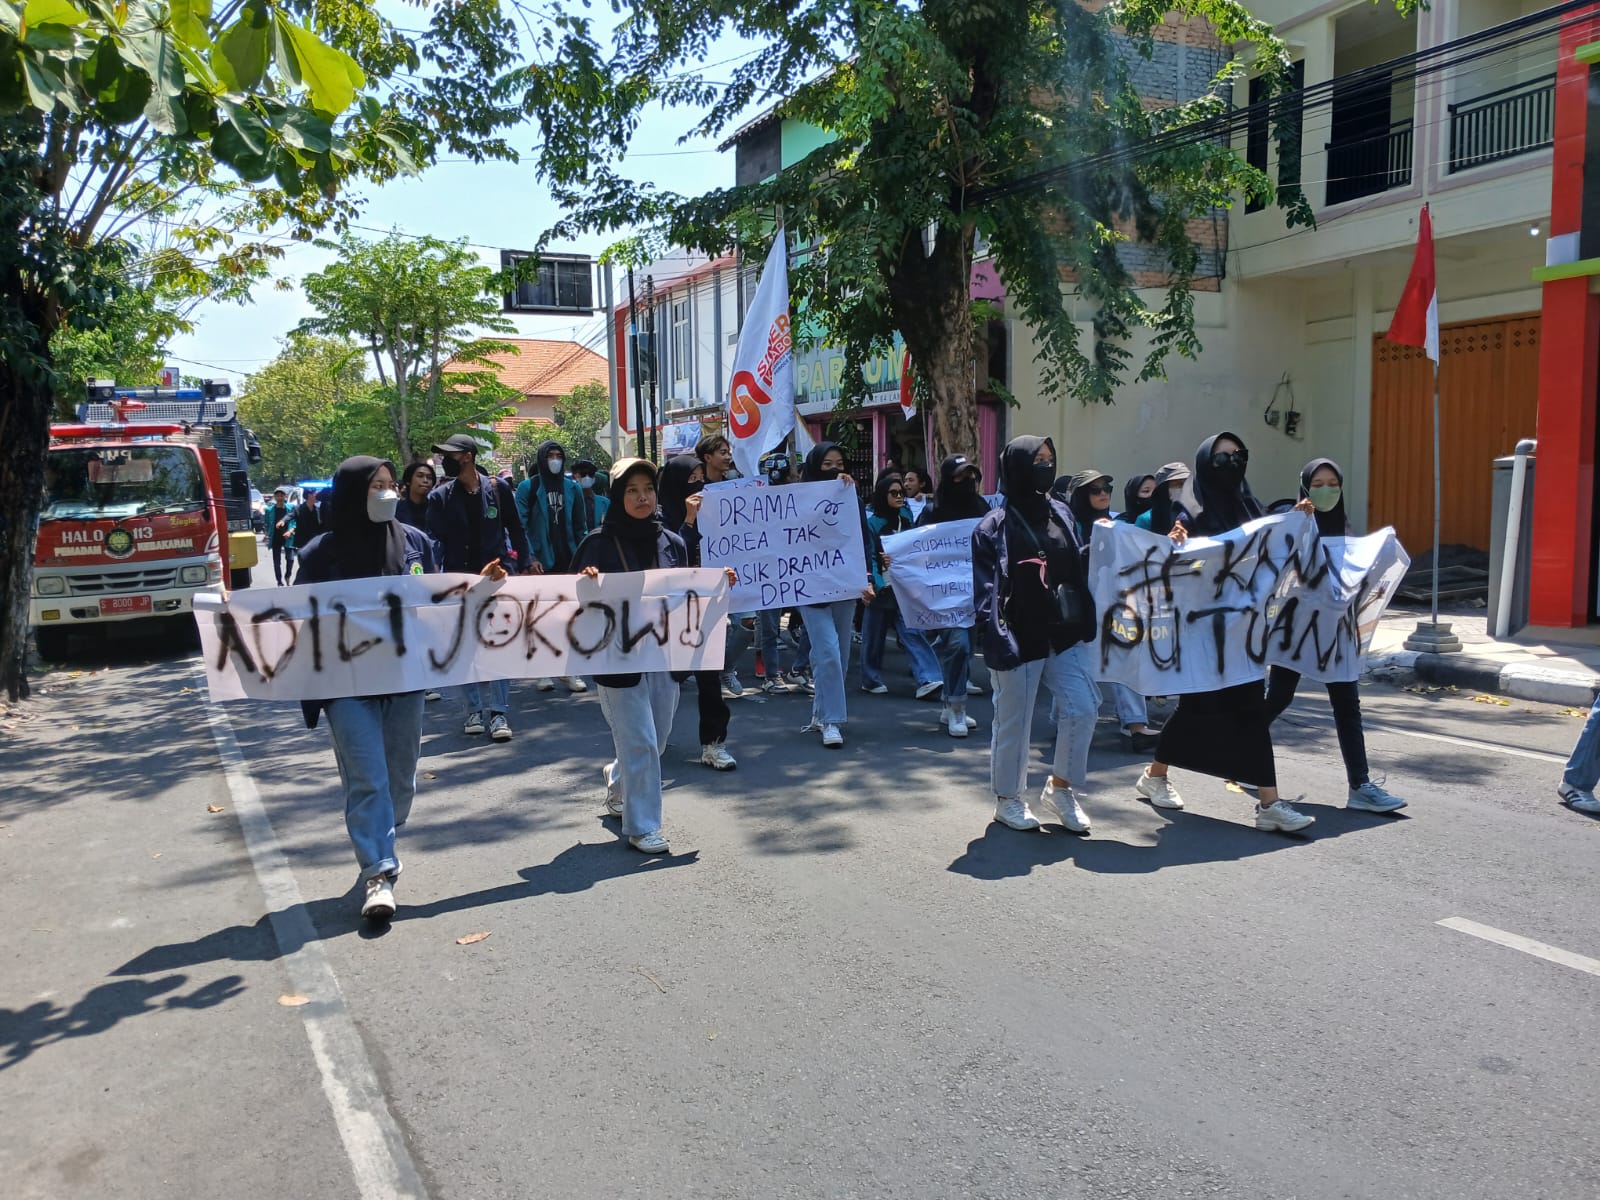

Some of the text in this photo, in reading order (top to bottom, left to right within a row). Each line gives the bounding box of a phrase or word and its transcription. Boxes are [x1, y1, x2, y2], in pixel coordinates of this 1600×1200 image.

[796, 344, 907, 396] PARUM
[719, 493, 798, 527] DRAMA
[62, 527, 153, 544] HALO 113
[707, 524, 821, 560] KOREA TAK
[909, 535, 972, 554] SUDAH KE
[777, 549, 845, 579] DRAMA
[101, 597, 150, 609] S 8000 JP
[760, 578, 813, 607] DPR
[926, 581, 972, 598] TURU
[216, 591, 406, 683] ADILI
